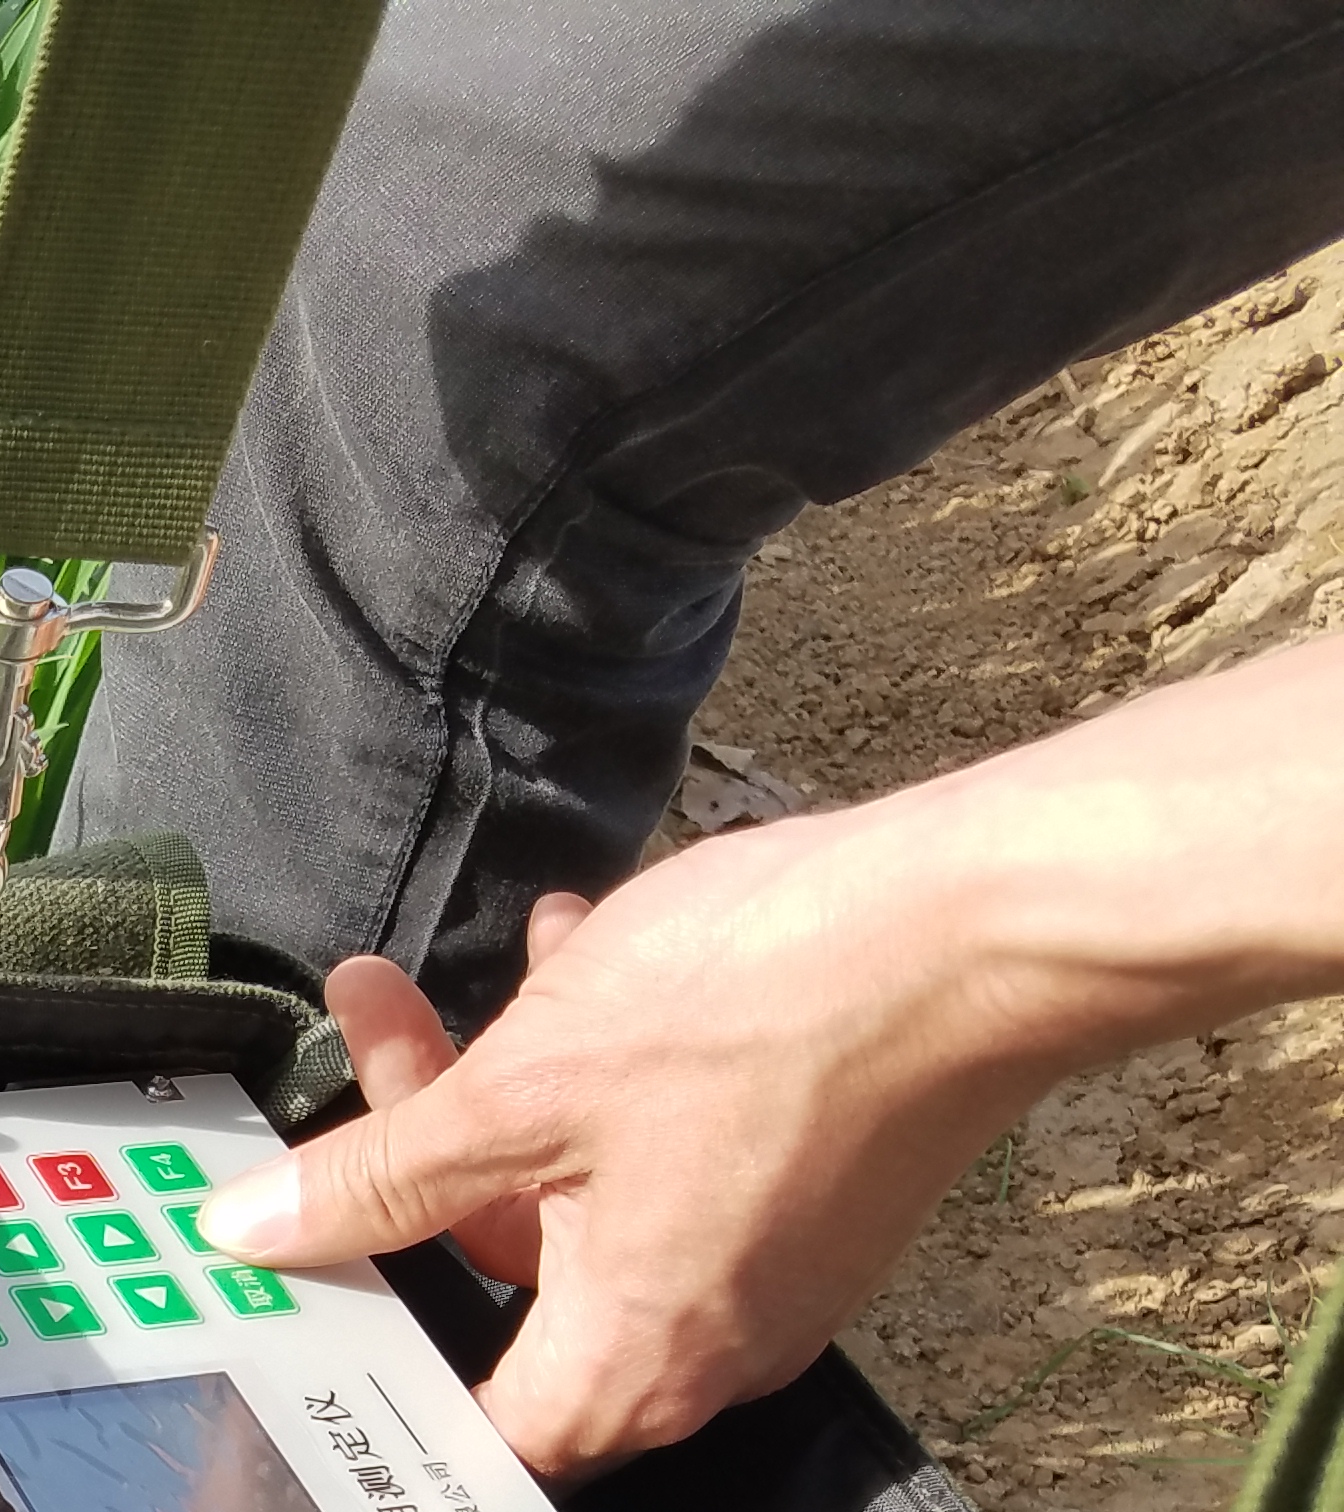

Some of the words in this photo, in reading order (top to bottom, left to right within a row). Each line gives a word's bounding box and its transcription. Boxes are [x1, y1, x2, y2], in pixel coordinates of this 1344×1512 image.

[57, 1161, 93, 1191] F3
[149, 1152, 186, 1181] F4
[230, 1267, 275, 1310] 取消
